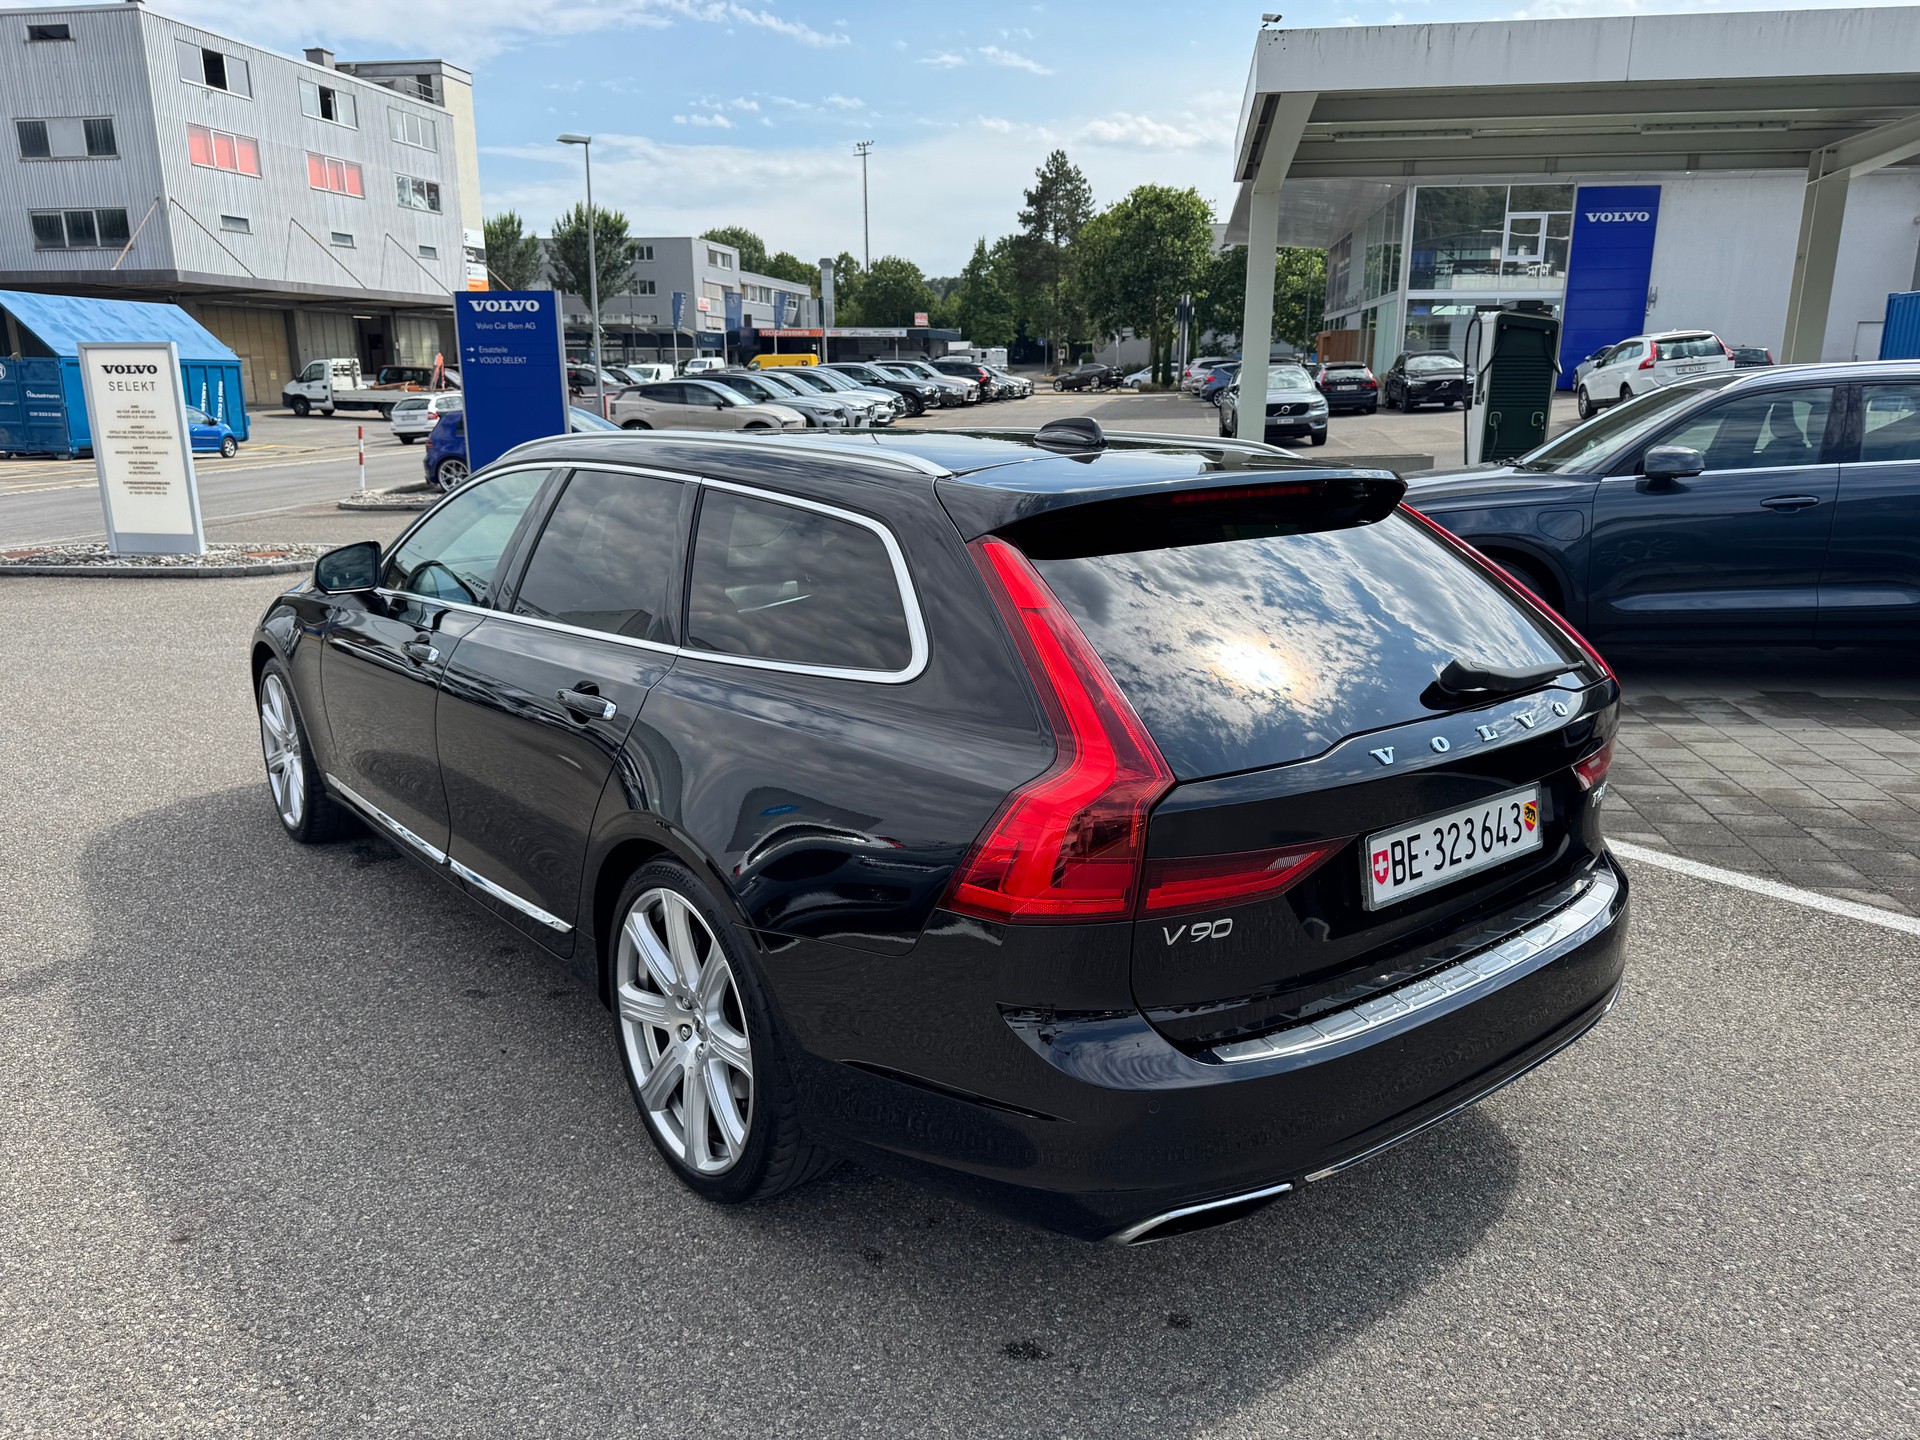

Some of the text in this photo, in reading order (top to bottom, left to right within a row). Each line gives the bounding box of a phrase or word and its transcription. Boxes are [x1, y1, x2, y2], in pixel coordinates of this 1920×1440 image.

[1584, 211, 1650, 223] VOLVO
[468, 299, 540, 312] VOLVO
[475, 322, 536, 330] Volvo Car Bern AG
[101, 364, 158, 375] VOLVO
[108, 381, 156, 392] SELEKT
[1368, 701, 1570, 766] VOLVO
[1162, 917, 1234, 946] V90
[706, 909, 742, 976] Continental
